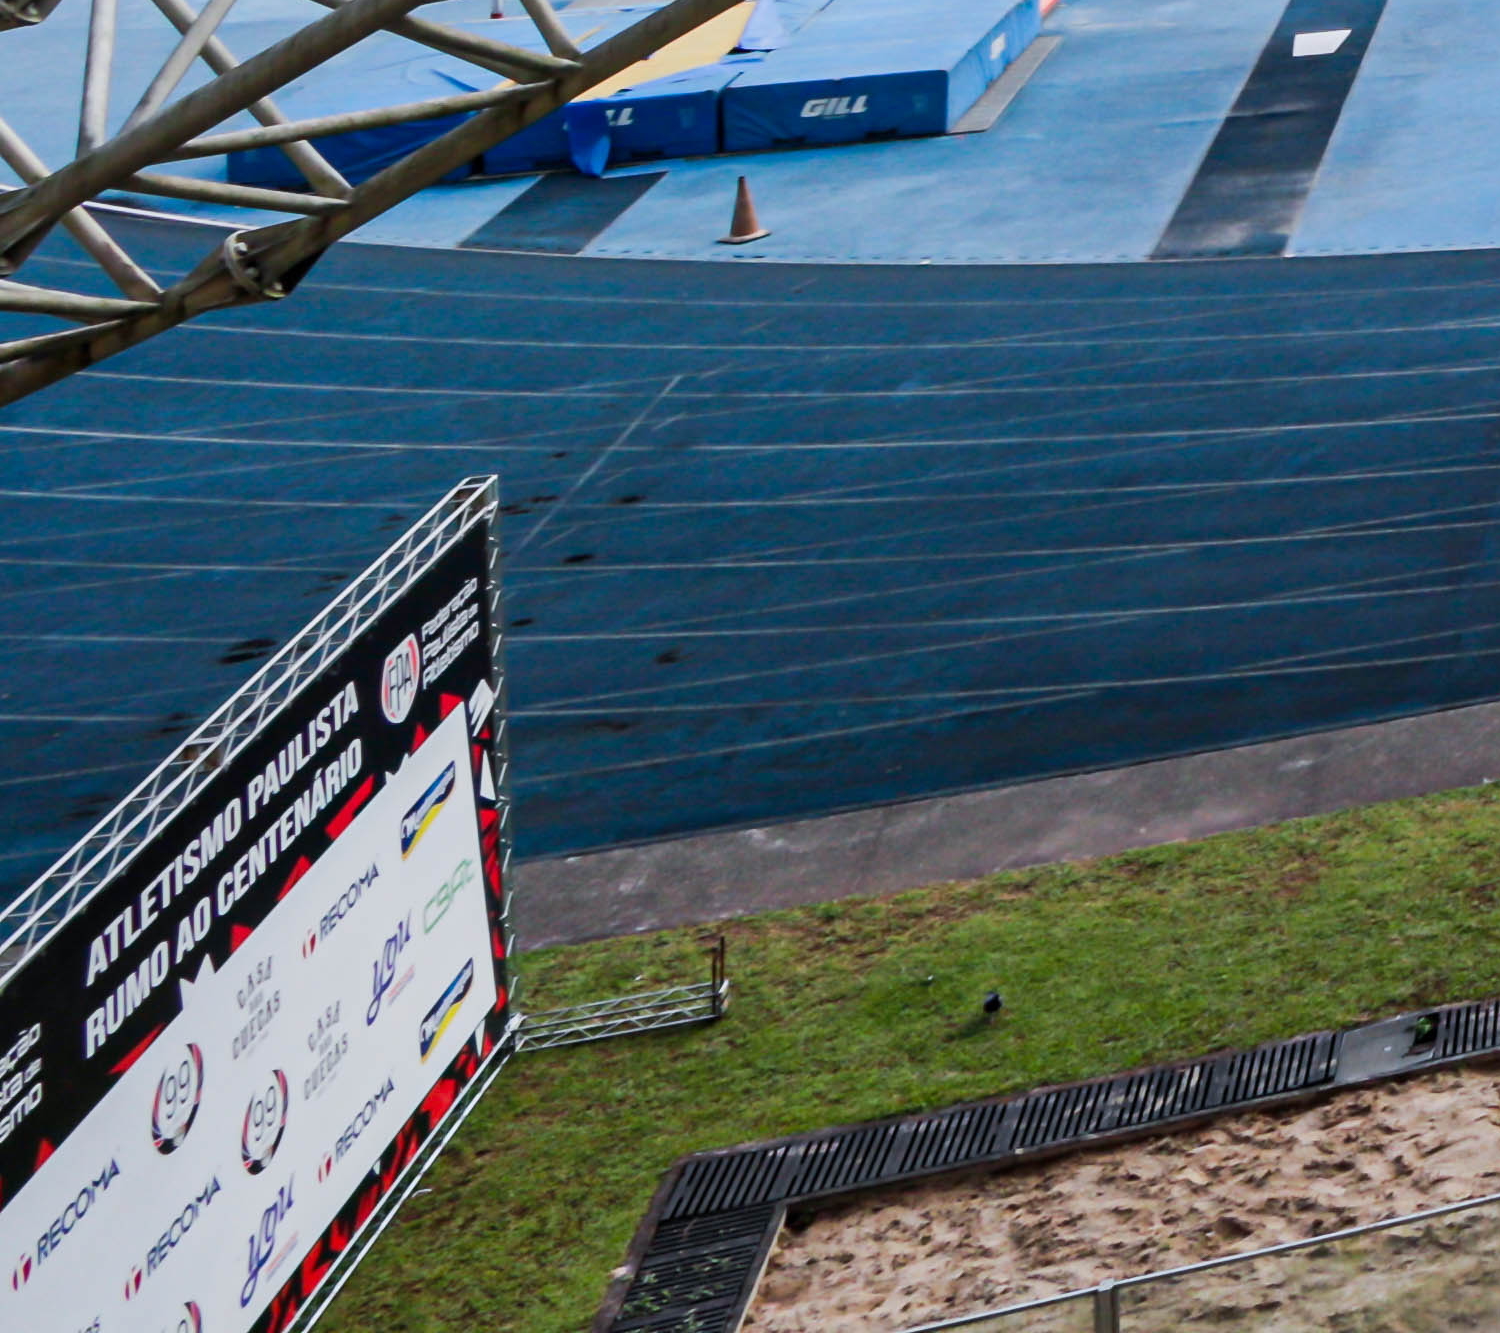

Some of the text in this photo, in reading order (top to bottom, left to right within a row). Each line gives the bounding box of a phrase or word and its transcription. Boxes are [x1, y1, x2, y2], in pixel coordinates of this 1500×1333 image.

[800, 95, 868, 118] GILL
[86, 680, 360, 988] ATLETISMO PAULISTA
[86, 738, 363, 1059] RUMO AO CENTENÁRIO
[320, 862, 379, 942] RECOMA
[237, 955, 272, 1010] CASA
[164, 1059, 191, 1120] 99
[253, 1084, 277, 1142] 99
[334, 1077, 394, 1163] RECOMA
[36, 1158, 120, 1266] RECOMA
[147, 1173, 221, 1277] RECOMA
